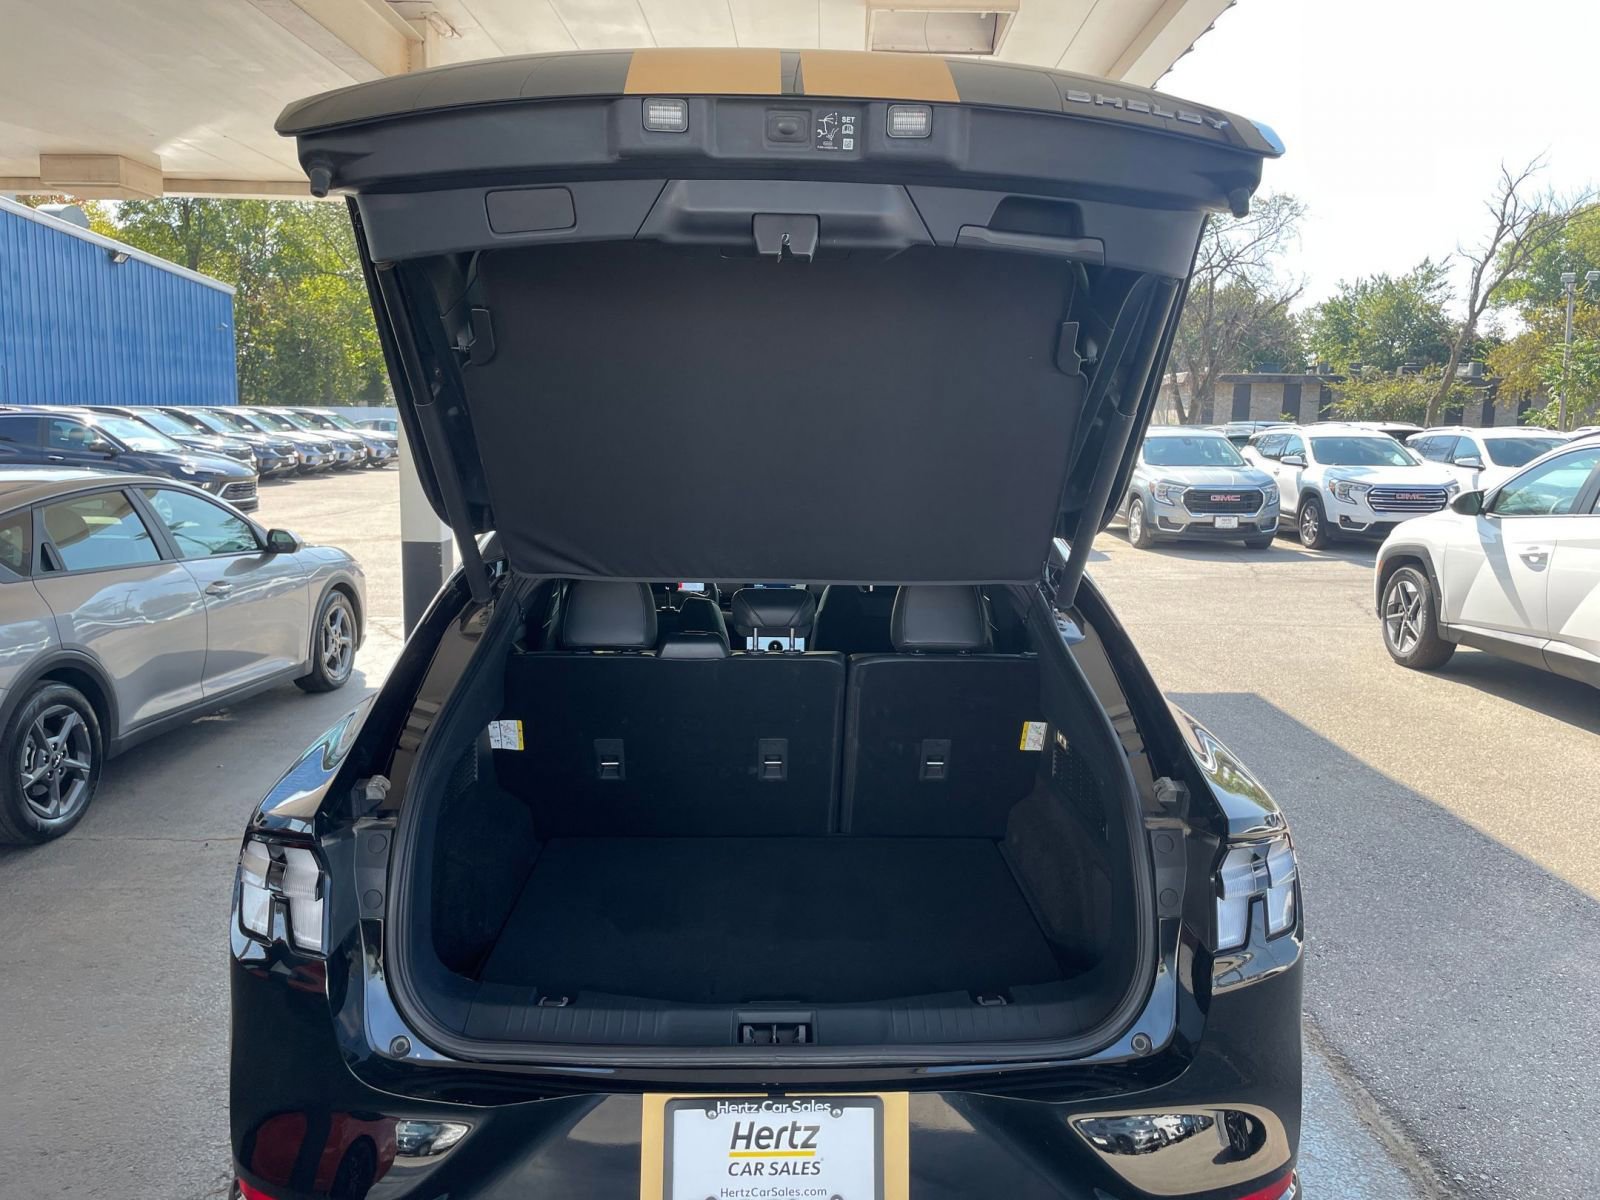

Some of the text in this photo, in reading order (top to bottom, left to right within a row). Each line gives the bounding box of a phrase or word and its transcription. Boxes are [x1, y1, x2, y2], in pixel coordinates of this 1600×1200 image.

[841, 116, 856, 124] SET
[1210, 494, 1241, 502] GMC
[1394, 492, 1425, 500] GMC
[716, 1099, 832, 1114] Hertz Car Sales
[730, 1120, 821, 1150] Hertz
[728, 1161, 821, 1176] CAR SALES
[720, 1186, 827, 1198] HertzCarSales.com
